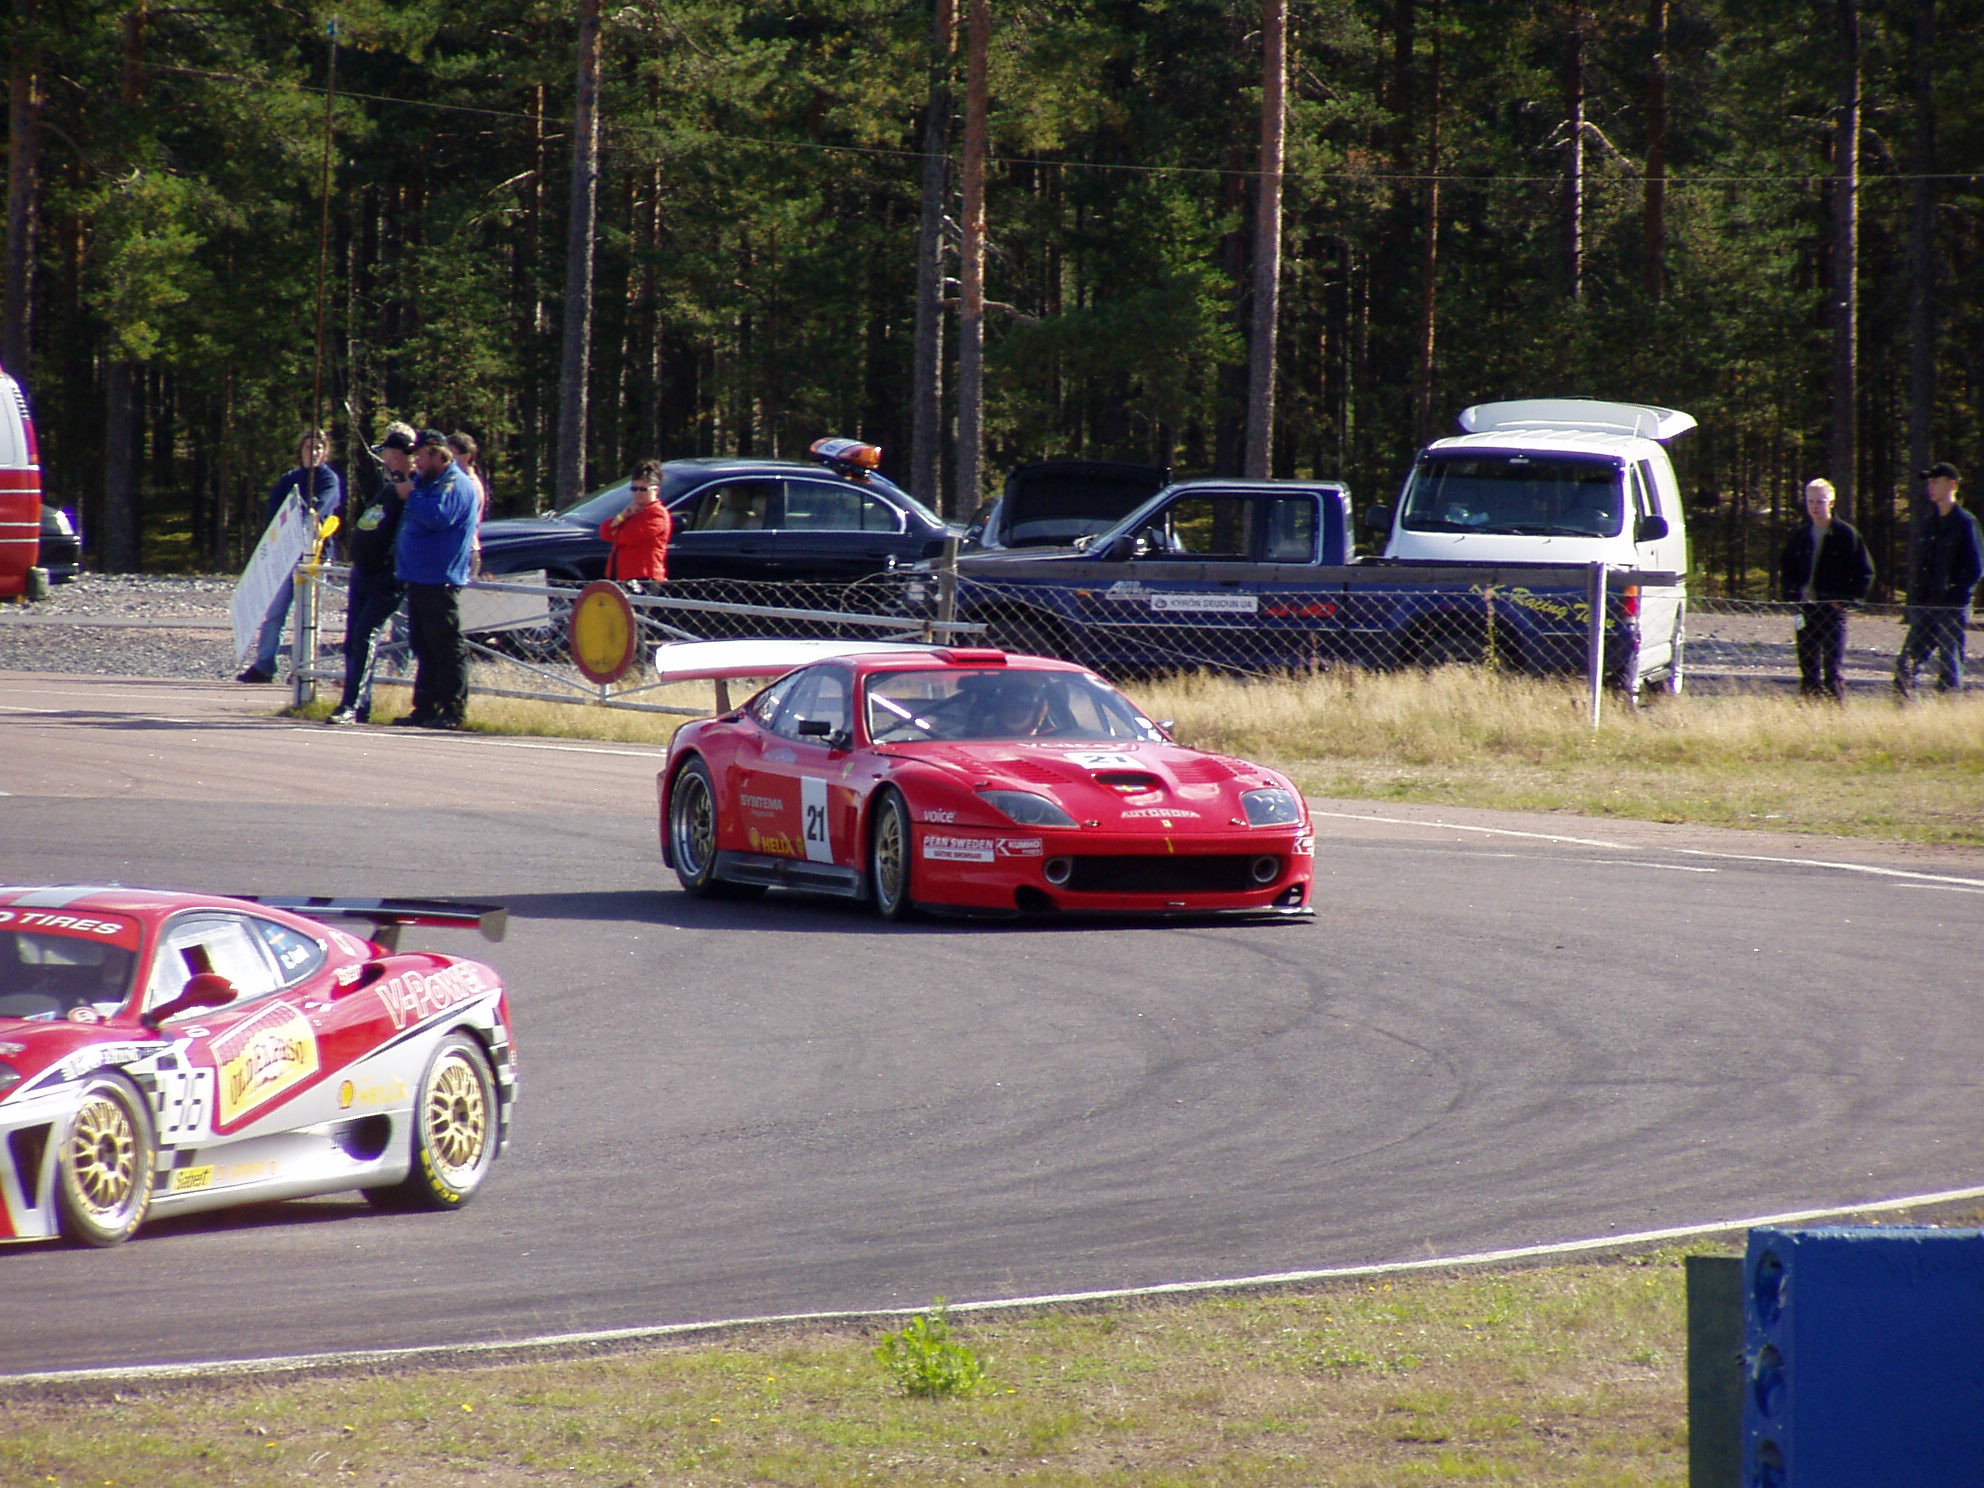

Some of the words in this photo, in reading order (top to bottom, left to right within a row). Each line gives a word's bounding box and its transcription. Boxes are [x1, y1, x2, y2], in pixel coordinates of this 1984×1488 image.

[1084, 755, 1127, 764] 21
[807, 804, 825, 842] 21
[761, 832, 797, 857] HELIX
[951, 838, 995, 850] SWEDEN
[18, 912, 123, 935] TIRES
